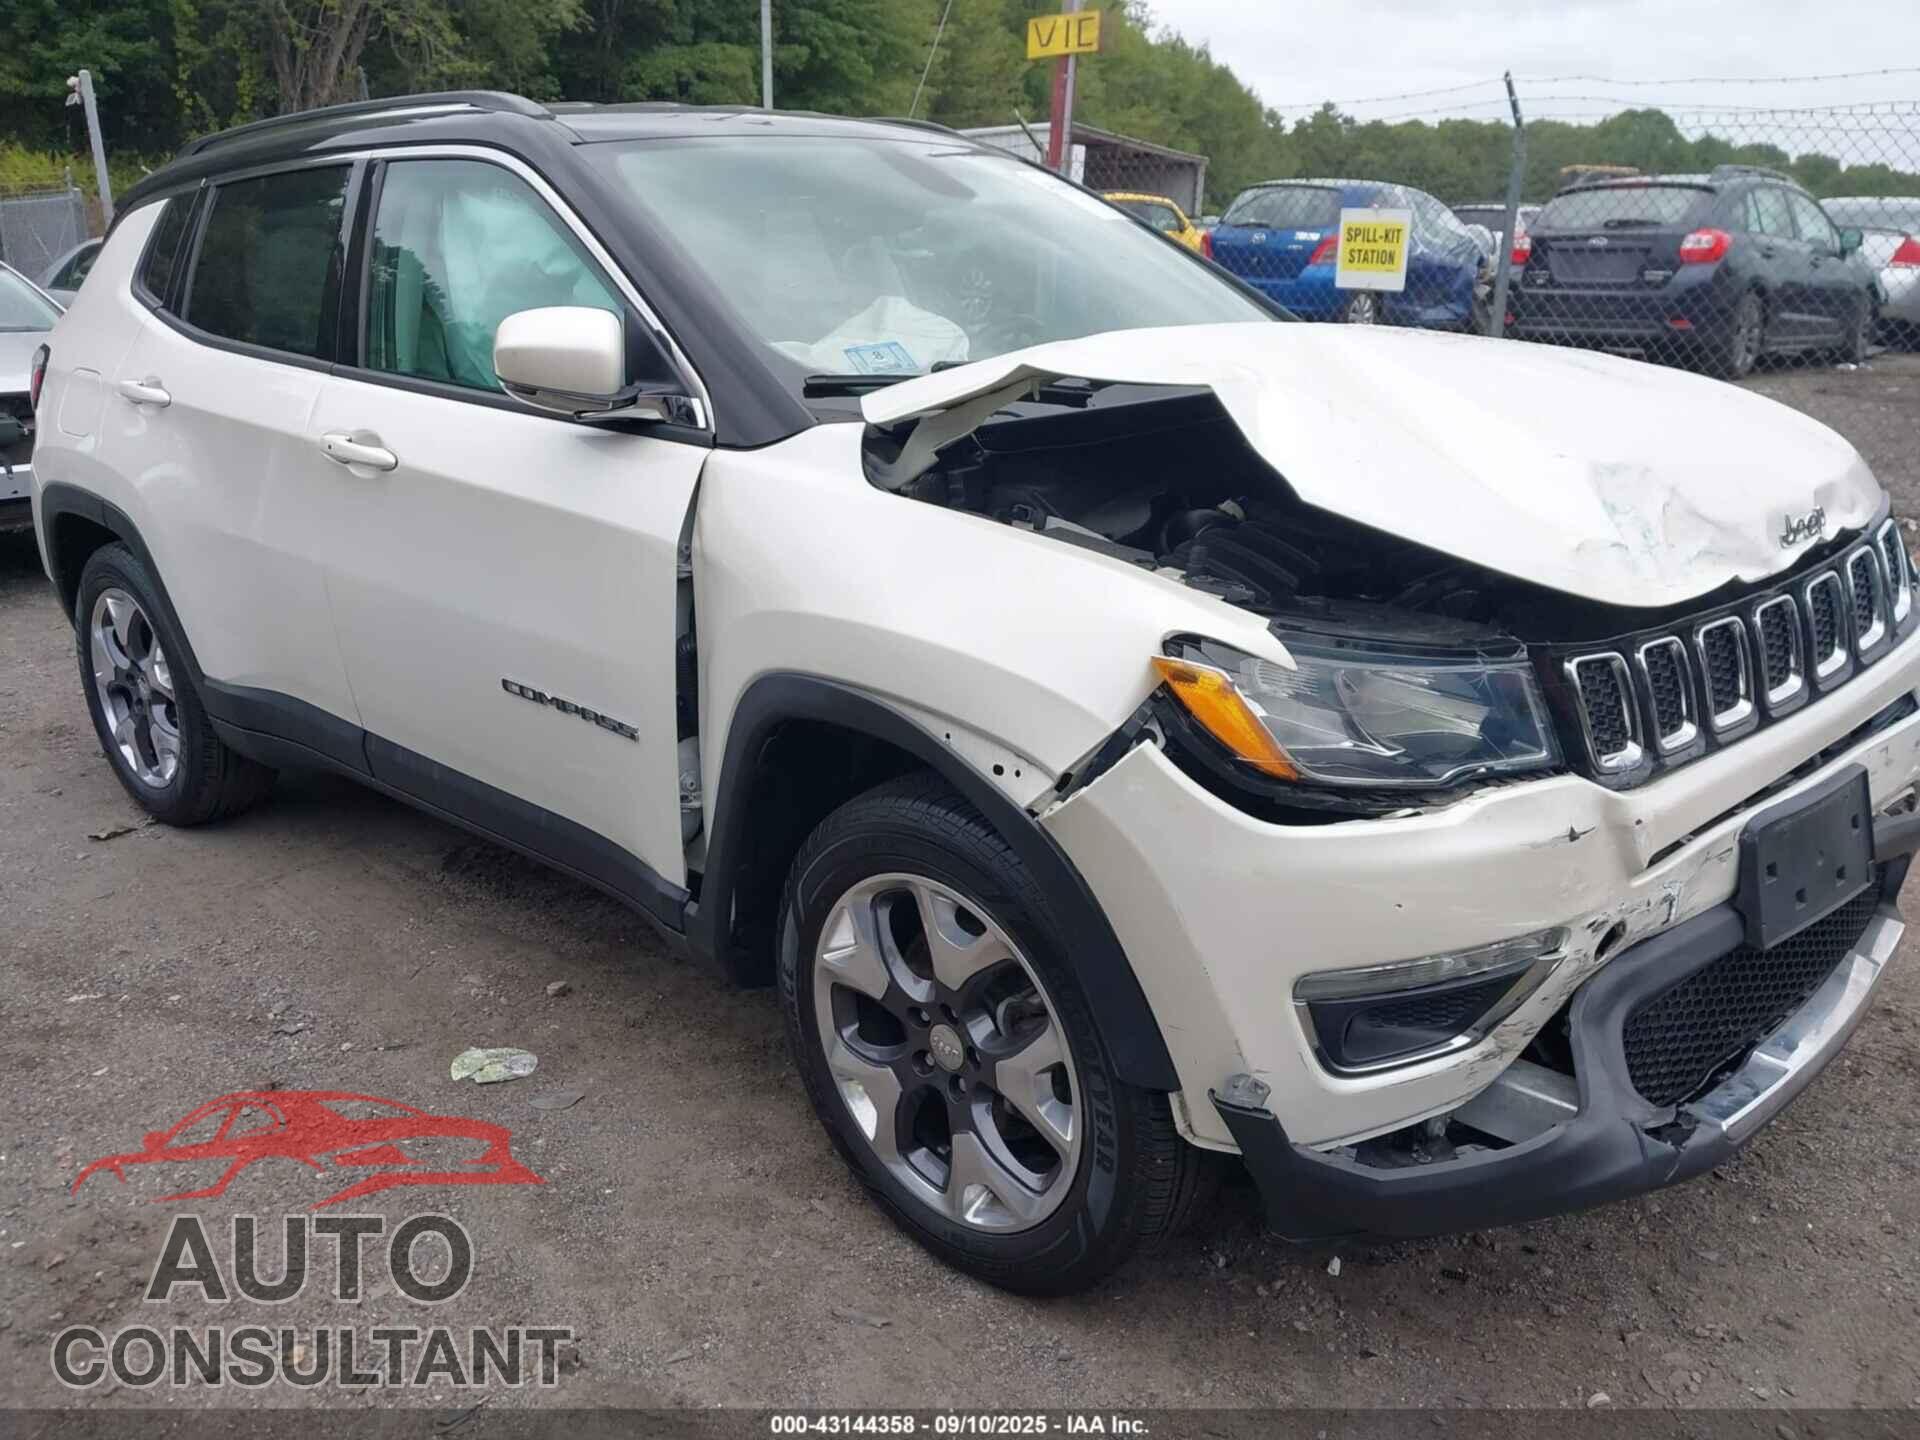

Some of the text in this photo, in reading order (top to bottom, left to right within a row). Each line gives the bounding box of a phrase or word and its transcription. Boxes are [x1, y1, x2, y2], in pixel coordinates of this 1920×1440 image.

[1033, 16, 1096, 48] VIC
[1346, 227, 1402, 243] SPILL-KIT
[1348, 248, 1395, 265] STATION
[501, 678, 640, 742] COMPASS
